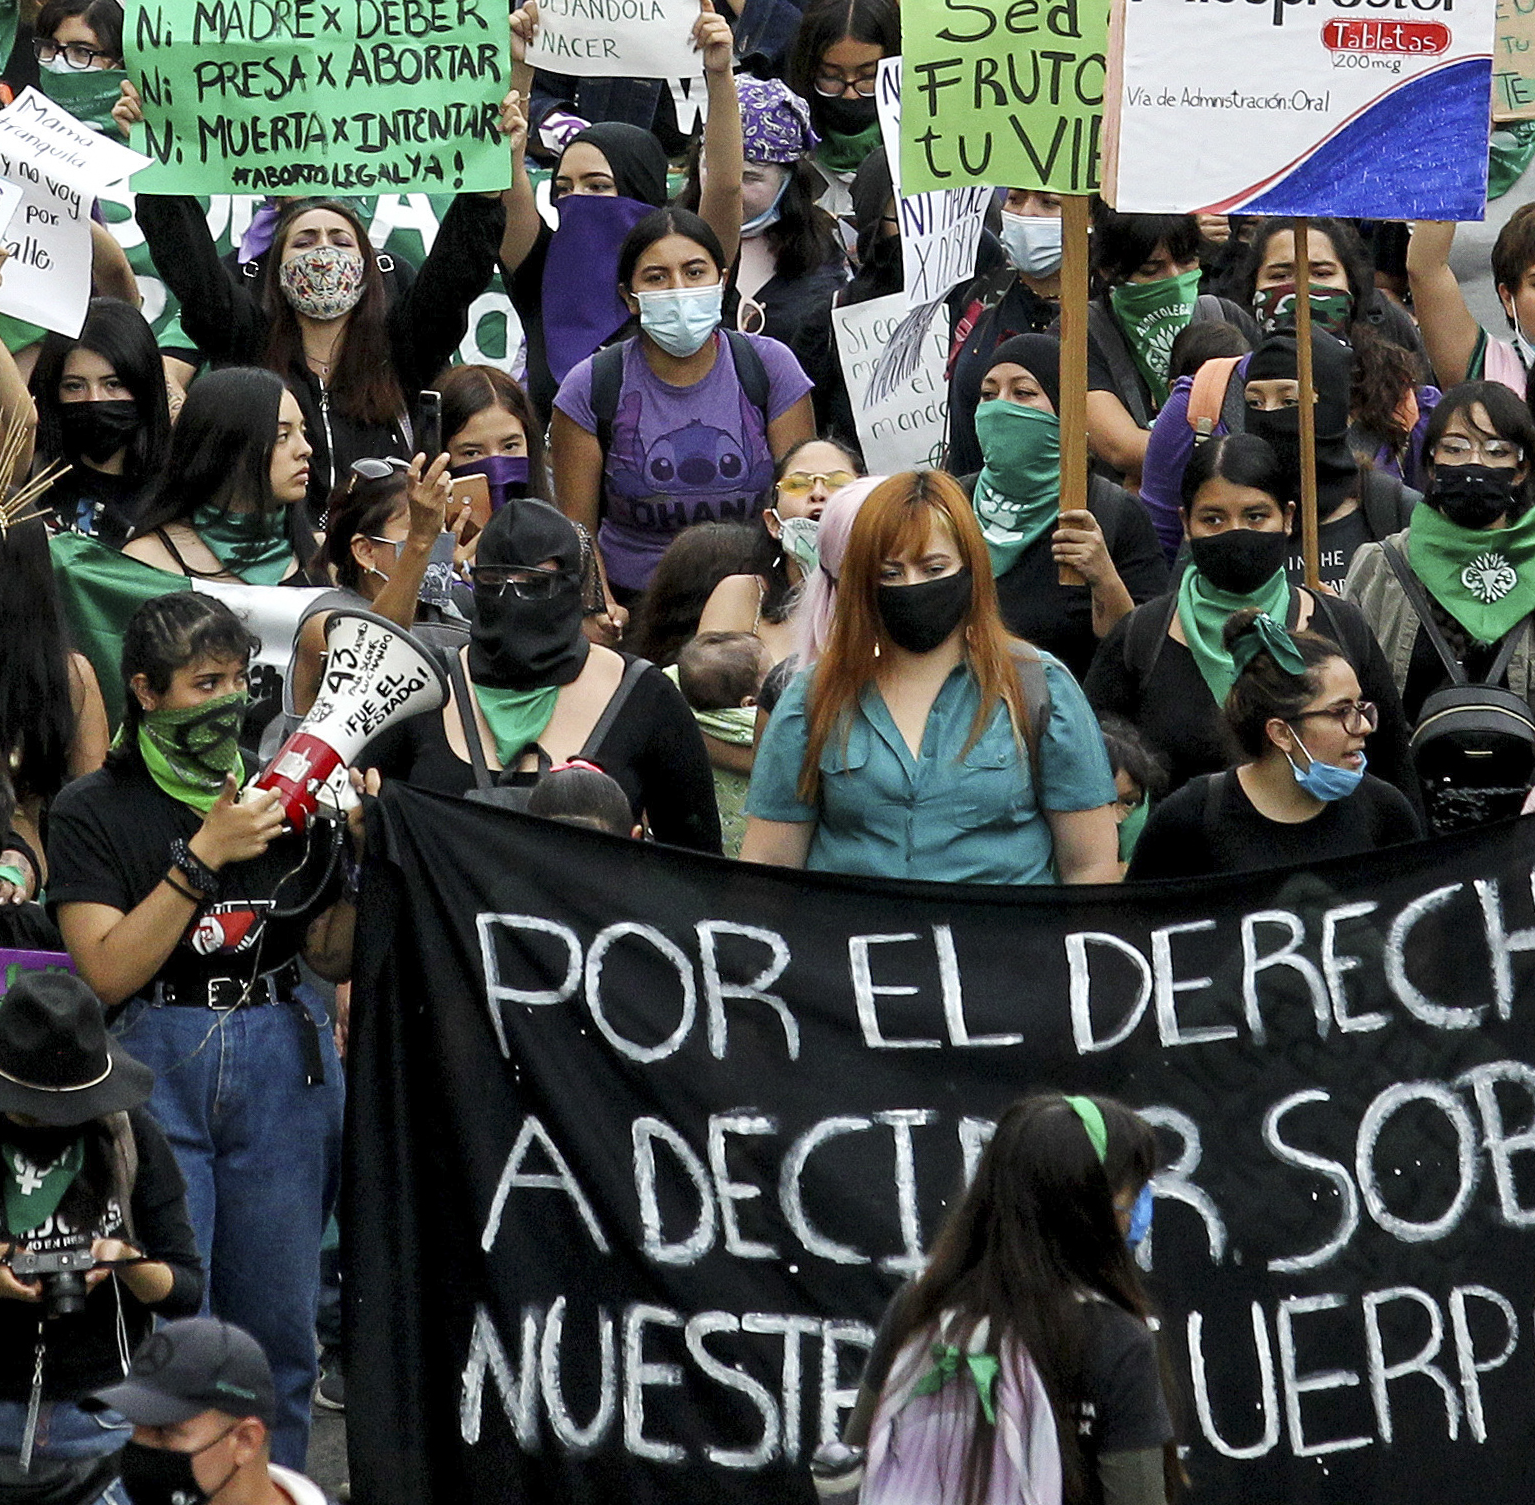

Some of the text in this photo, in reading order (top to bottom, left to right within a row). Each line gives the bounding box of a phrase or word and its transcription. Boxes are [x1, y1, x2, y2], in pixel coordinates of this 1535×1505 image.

[541, 29, 620, 59] NACER
[141, 70, 172, 107] Ni
[196, 52, 306, 103] PRESA
[345, 42, 500, 91] ABORTAR
[915, 125, 991, 178] tu
[841, 317, 869, 354] Si
[912, 371, 936, 394] el
[361, 666, 431, 736] ESTADO!
[473, 908, 802, 1064] POR
[848, 923, 1025, 1051] EL
